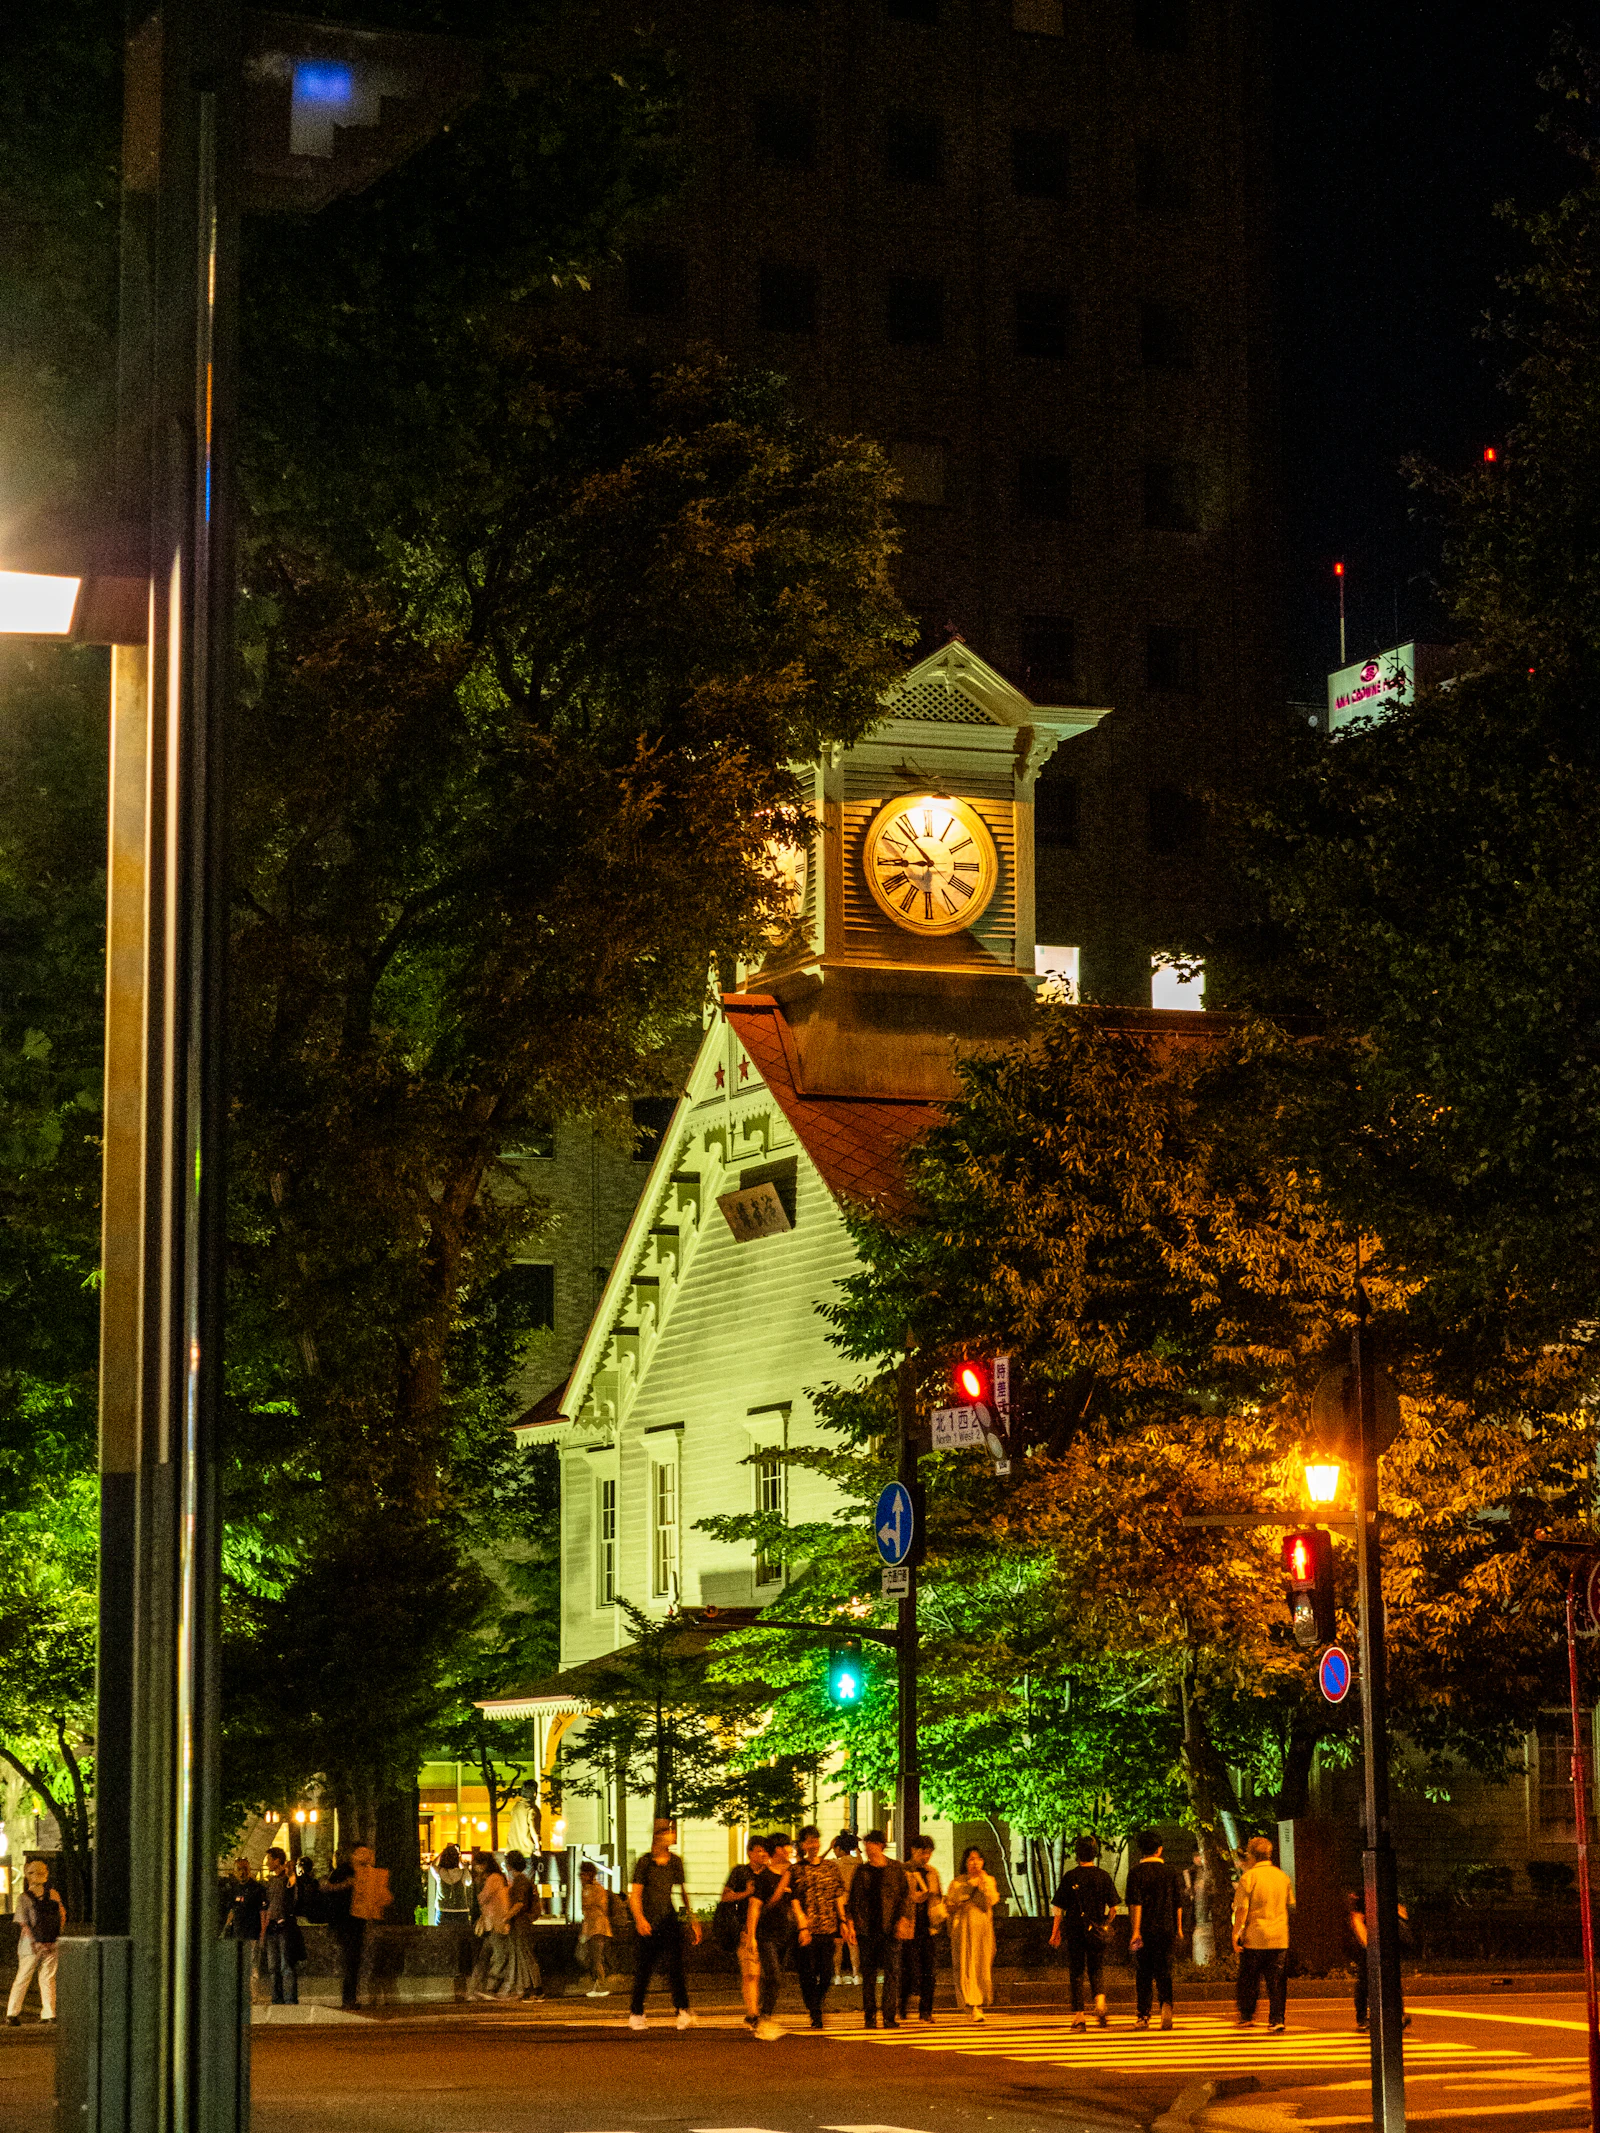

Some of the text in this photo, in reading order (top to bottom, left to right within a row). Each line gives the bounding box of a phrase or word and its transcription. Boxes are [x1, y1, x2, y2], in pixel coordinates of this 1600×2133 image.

[899, 814, 919, 842] XI
[939, 817, 955, 842] I
[881, 830, 908, 854] X
[948, 837, 973, 855] II
[953, 861, 979, 873] III
[881, 871, 910, 896] VIII
[948, 874, 976, 900] IIII
[899, 885, 919, 914] VII
[924, 891, 934, 920] VI
[941, 888, 959, 916] V
[953, 1431, 958, 1443] 1
[976, 1428, 981, 1440] 2
